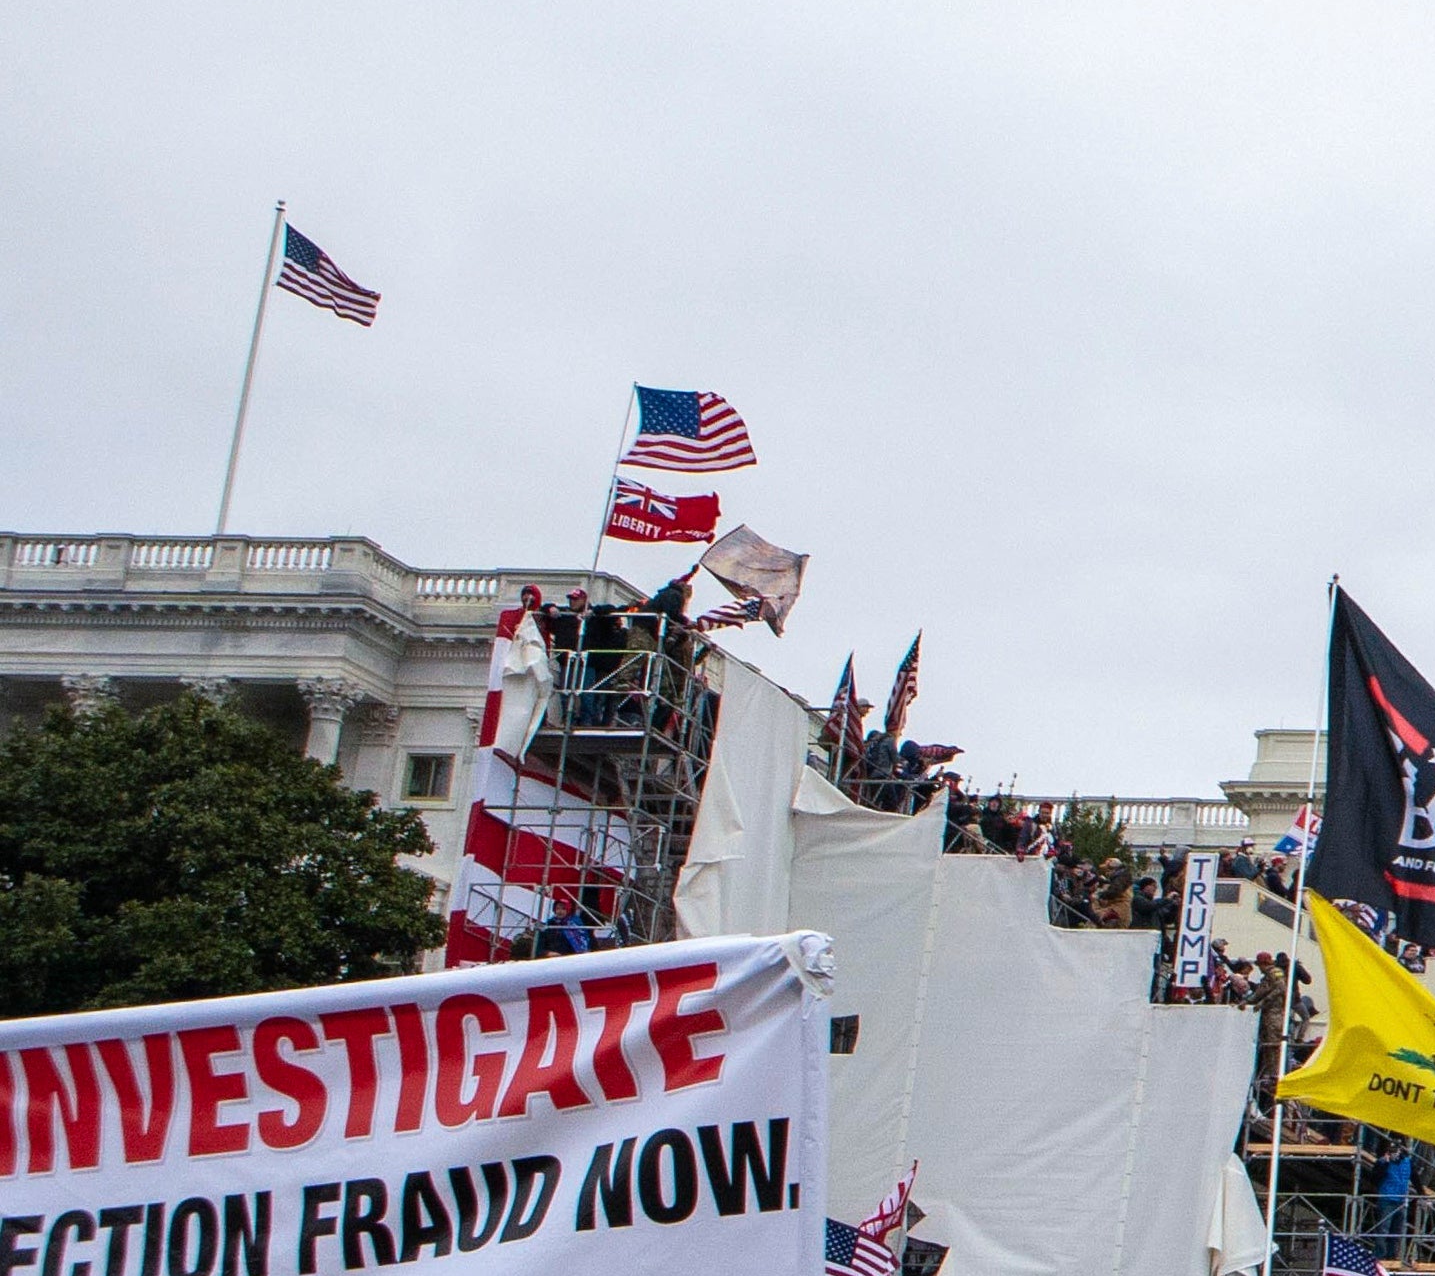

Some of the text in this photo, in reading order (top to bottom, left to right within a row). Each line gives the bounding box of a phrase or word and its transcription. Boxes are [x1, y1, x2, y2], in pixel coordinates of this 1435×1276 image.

[612, 513, 662, 538] LIBERTY
[1393, 855, 1425, 871] AND
[1180, 858, 1212, 983] TRUMP
[1367, 1072, 1425, 1105] DONT
[298, 1153, 562, 1276] FRAUD
[575, 1117, 799, 1232] NOW.
